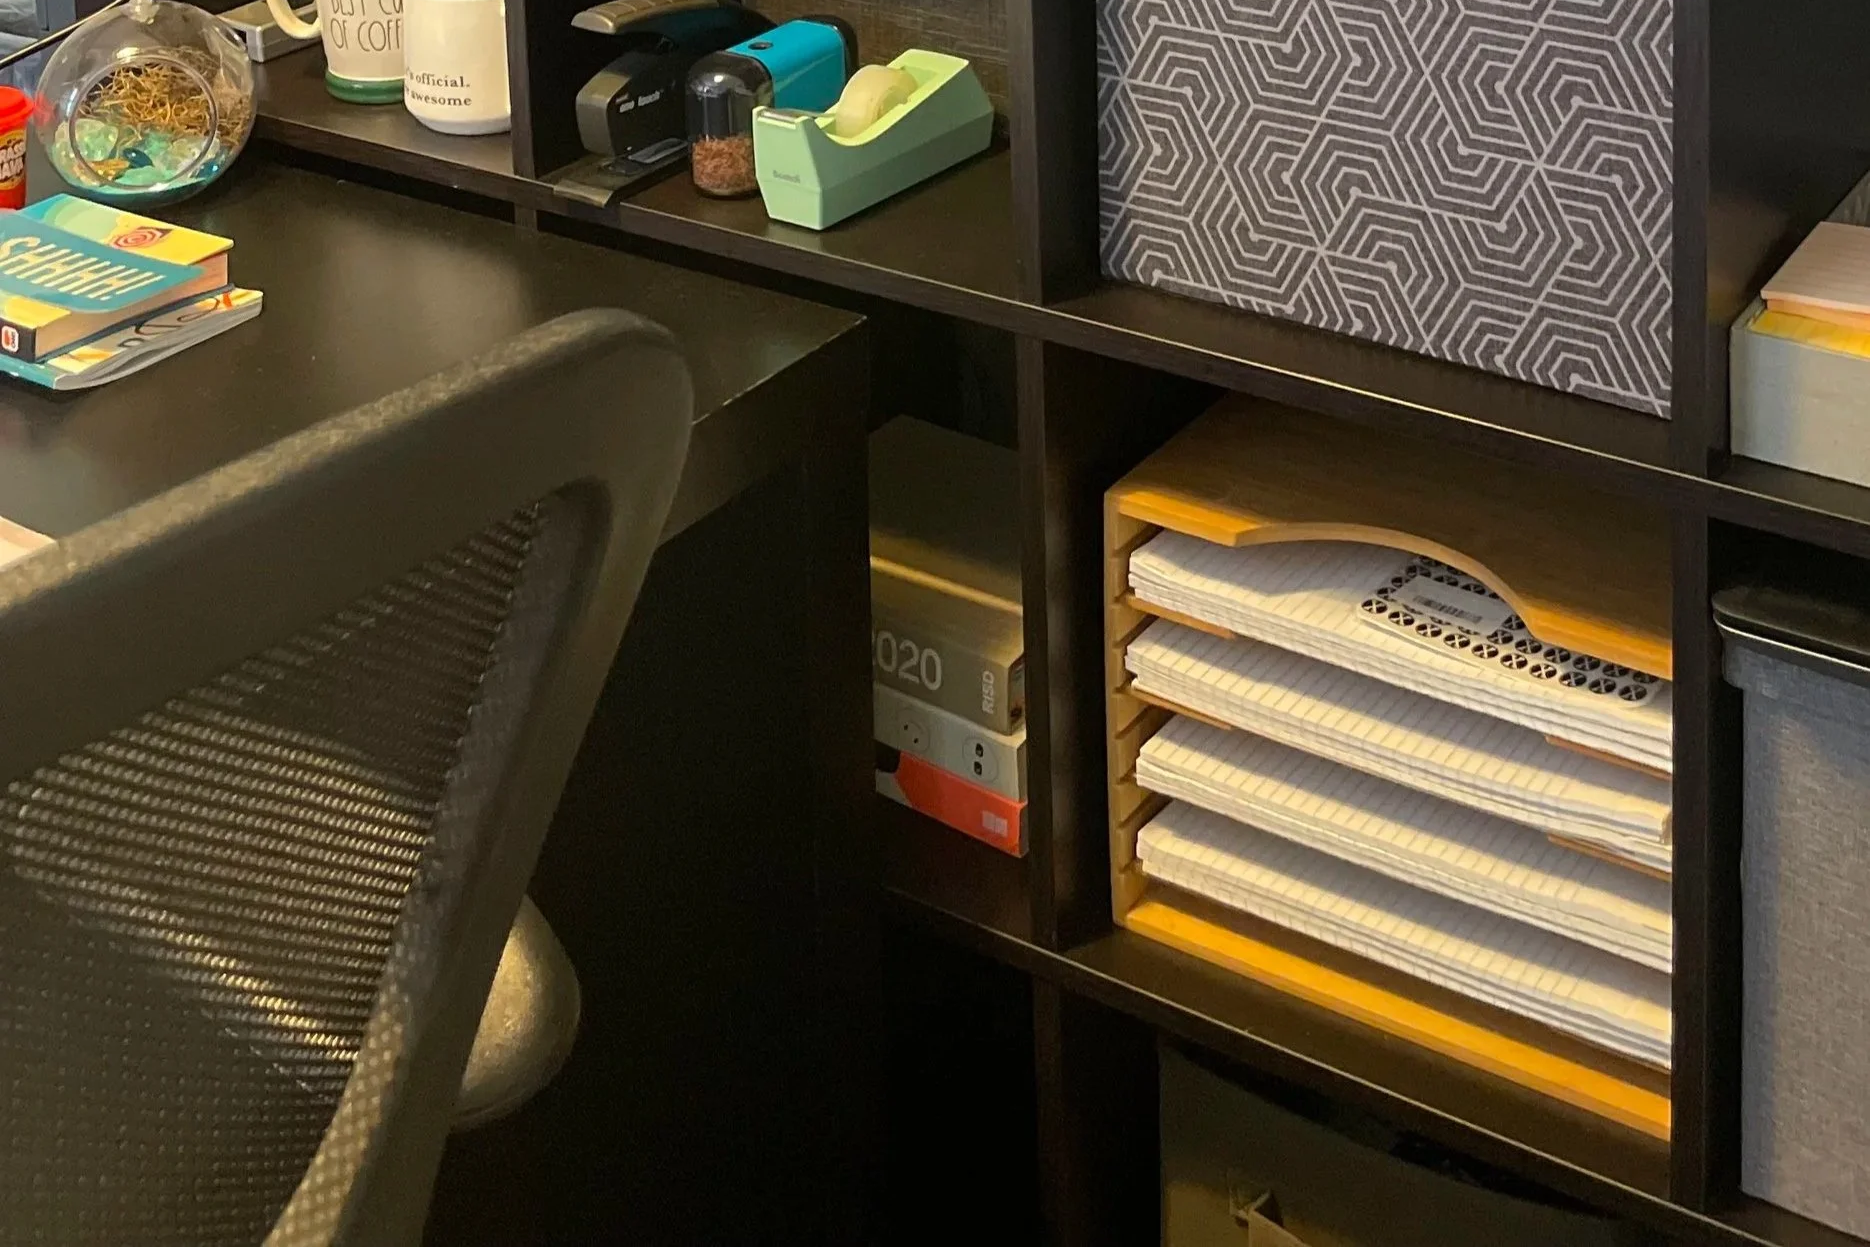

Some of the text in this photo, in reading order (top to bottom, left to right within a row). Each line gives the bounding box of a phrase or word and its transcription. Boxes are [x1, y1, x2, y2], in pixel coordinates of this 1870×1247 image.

[330, 17, 401, 52] OF COFF
[411, 89, 472, 107] awesome
[415, 72, 471, 89] official.
[872, 628, 942, 692] 020
[981, 669, 995, 715] RISD
